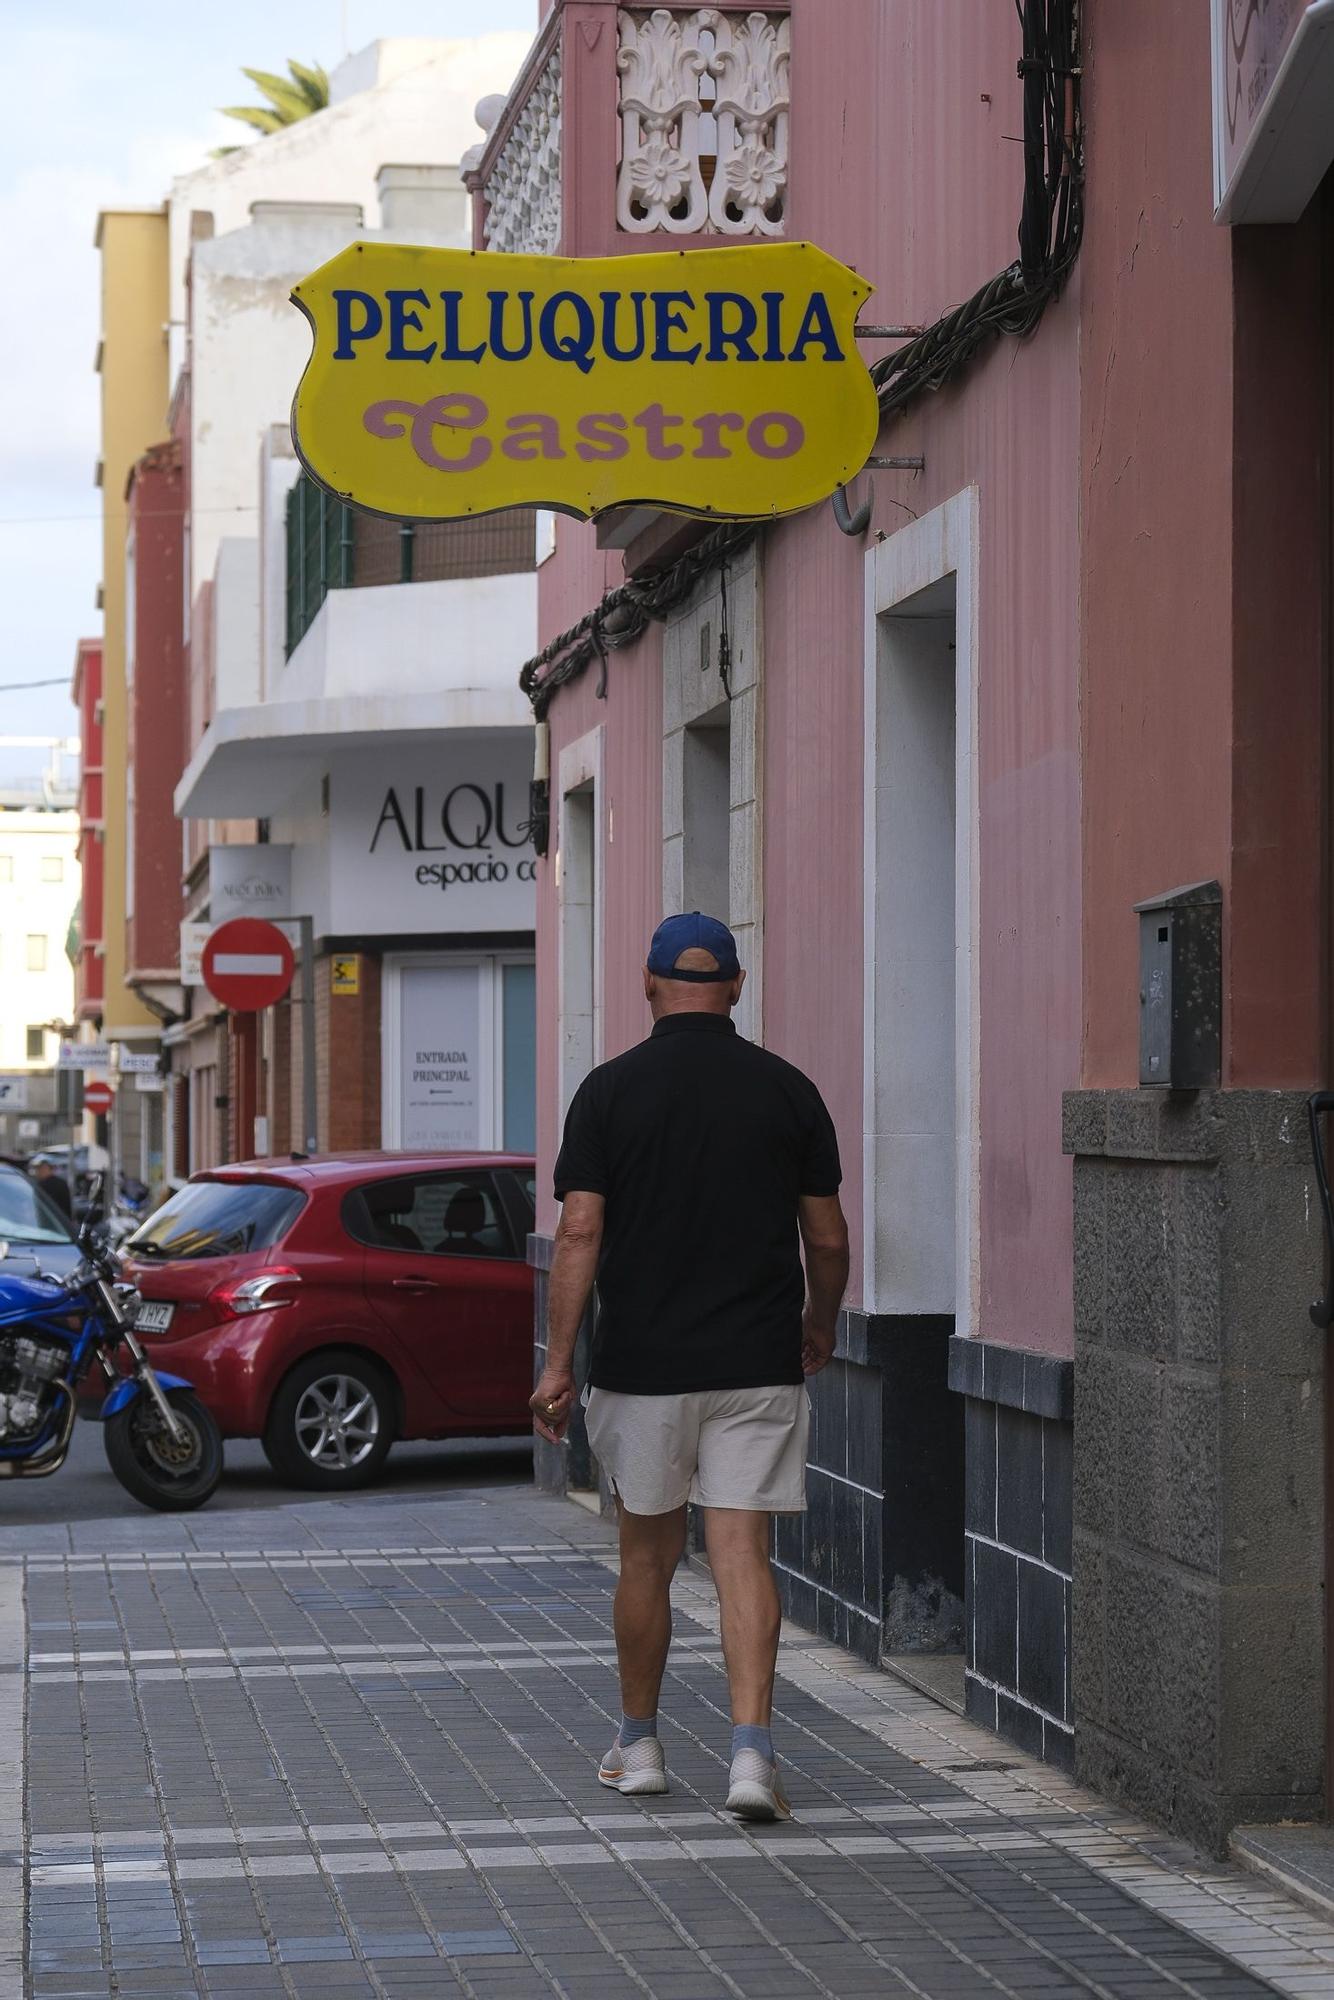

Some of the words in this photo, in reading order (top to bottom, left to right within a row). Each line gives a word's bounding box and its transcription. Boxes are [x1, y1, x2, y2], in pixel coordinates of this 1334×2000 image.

[332, 288, 846, 374] PELUQUERIA
[362, 392, 806, 472] Castro
[415, 854, 509, 891] espacio
[412, 1070, 471, 1082] PRINCIPAL
[415, 1051, 468, 1064] ENTRADA
